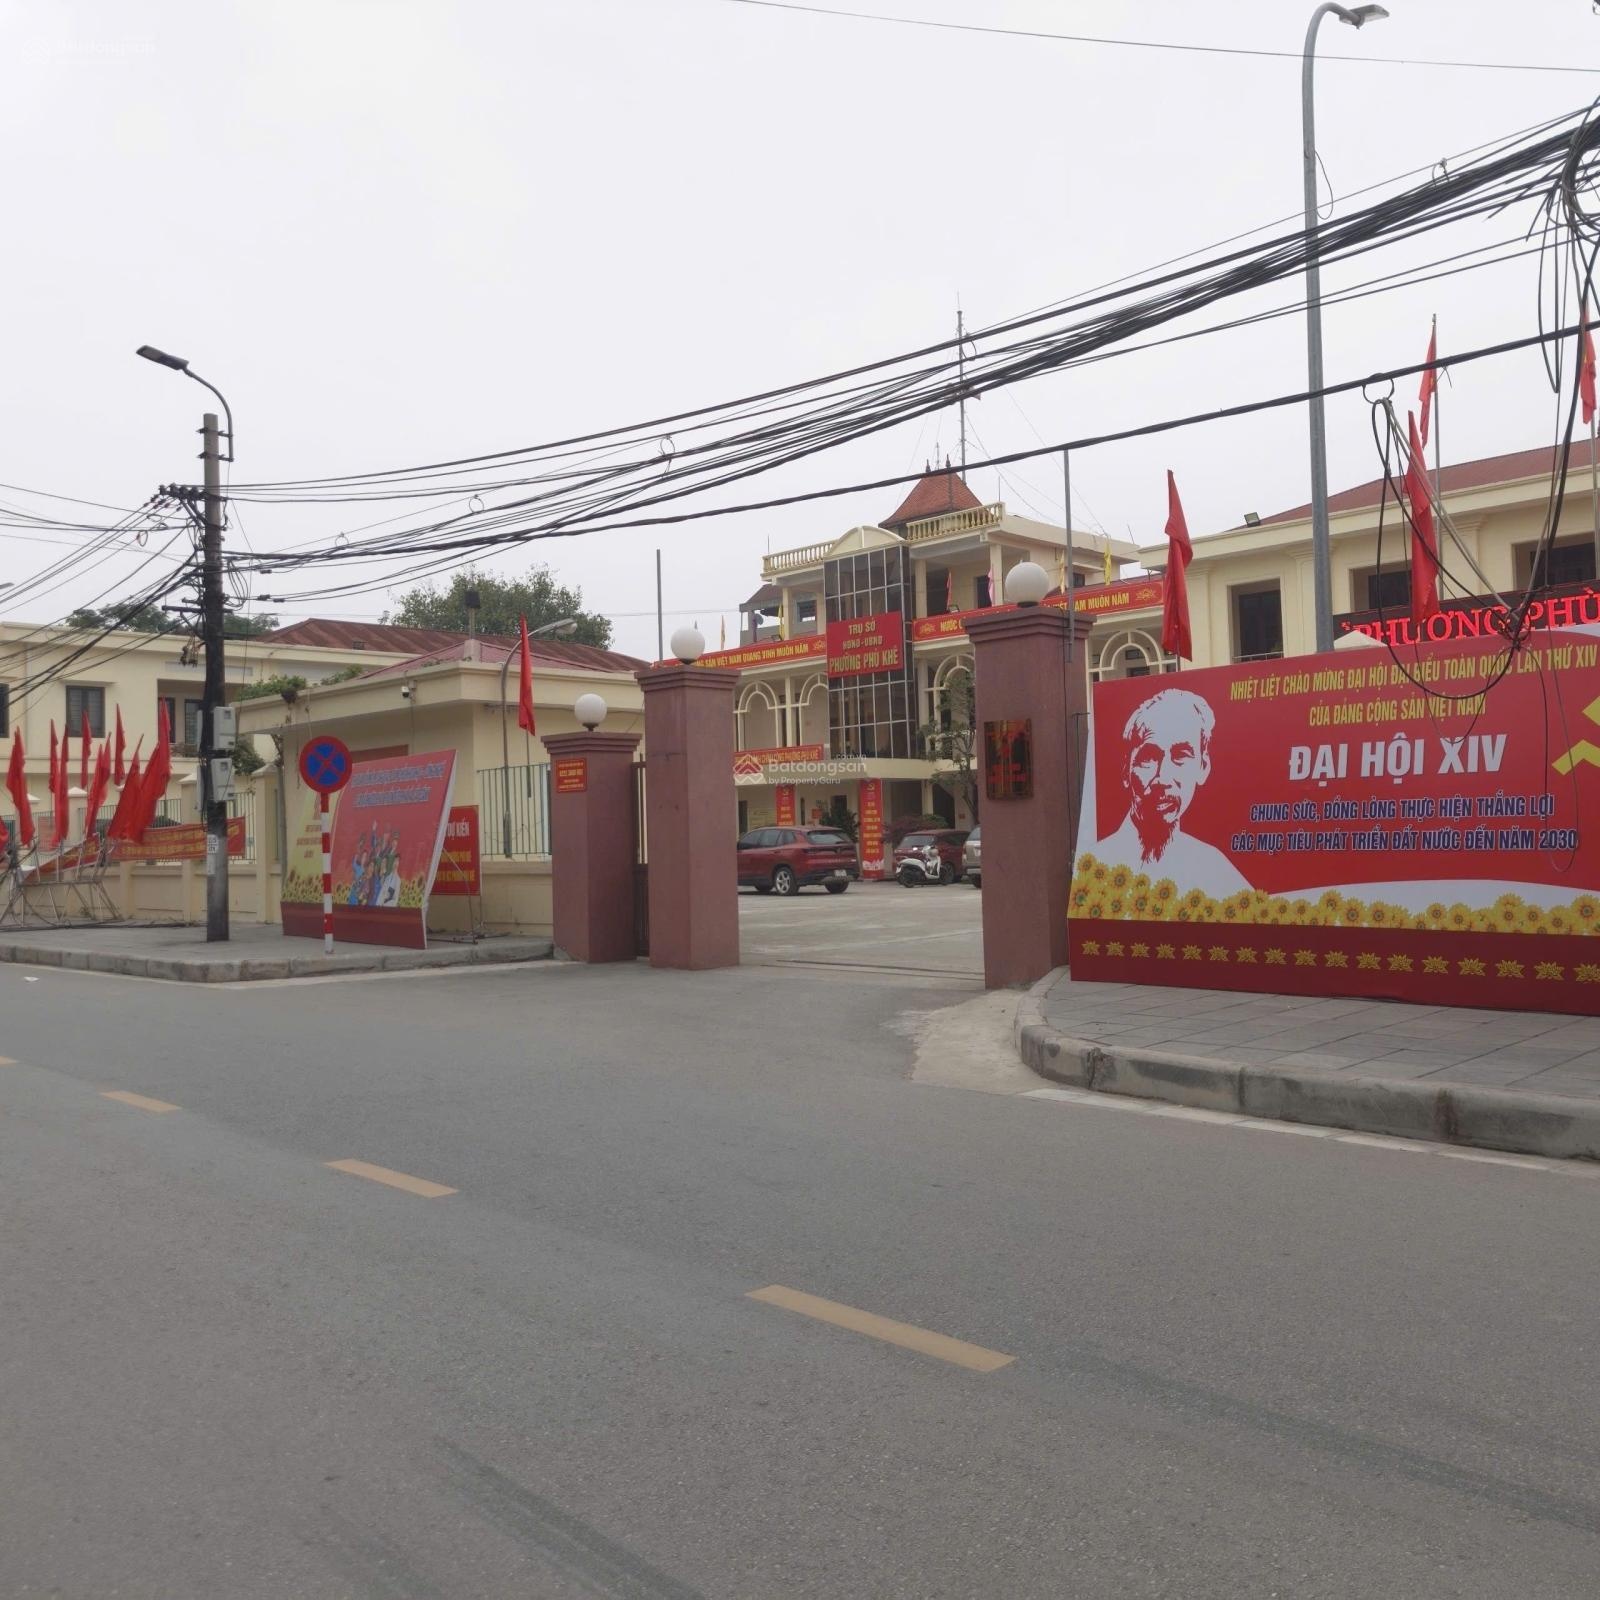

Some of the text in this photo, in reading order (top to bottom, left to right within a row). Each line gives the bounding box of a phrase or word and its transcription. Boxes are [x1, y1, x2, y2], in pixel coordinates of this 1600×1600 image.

[1088, 594, 1110, 609] MUÔN
[1111, 592, 1129, 605] NĂM
[729, 654, 741, 664] NAM
[829, 651, 861, 673] PHƯỜNG
[1230, 642, 1598, 703] NHIỆT LIỆT CHÀO MỪNG ĐẠI HỘI ĐẠI BIỂU TOÀN QUỐC LẦN THỨ XIV
[1309, 692, 1486, 727] CỦA ĐẢNG CỘNG SẢN VIỆT NAM
[1289, 732, 1507, 787] ĐẠI HỘI XIV
[1250, 802, 1289, 822] CHUNG
[1324, 794, 1359, 820] ĐỒNG
[1400, 797, 1435, 822] THỰC
[1439, 794, 1473, 822] HIỆN
[1476, 789, 1526, 817] THẮNG
[1529, 792, 1555, 820] LỢI
[1231, 824, 1578, 856] CÁC MỤC TIÊU PHÁT TRIỂN ĐẤT NƯỚC ĐẾN NĂM 2030
